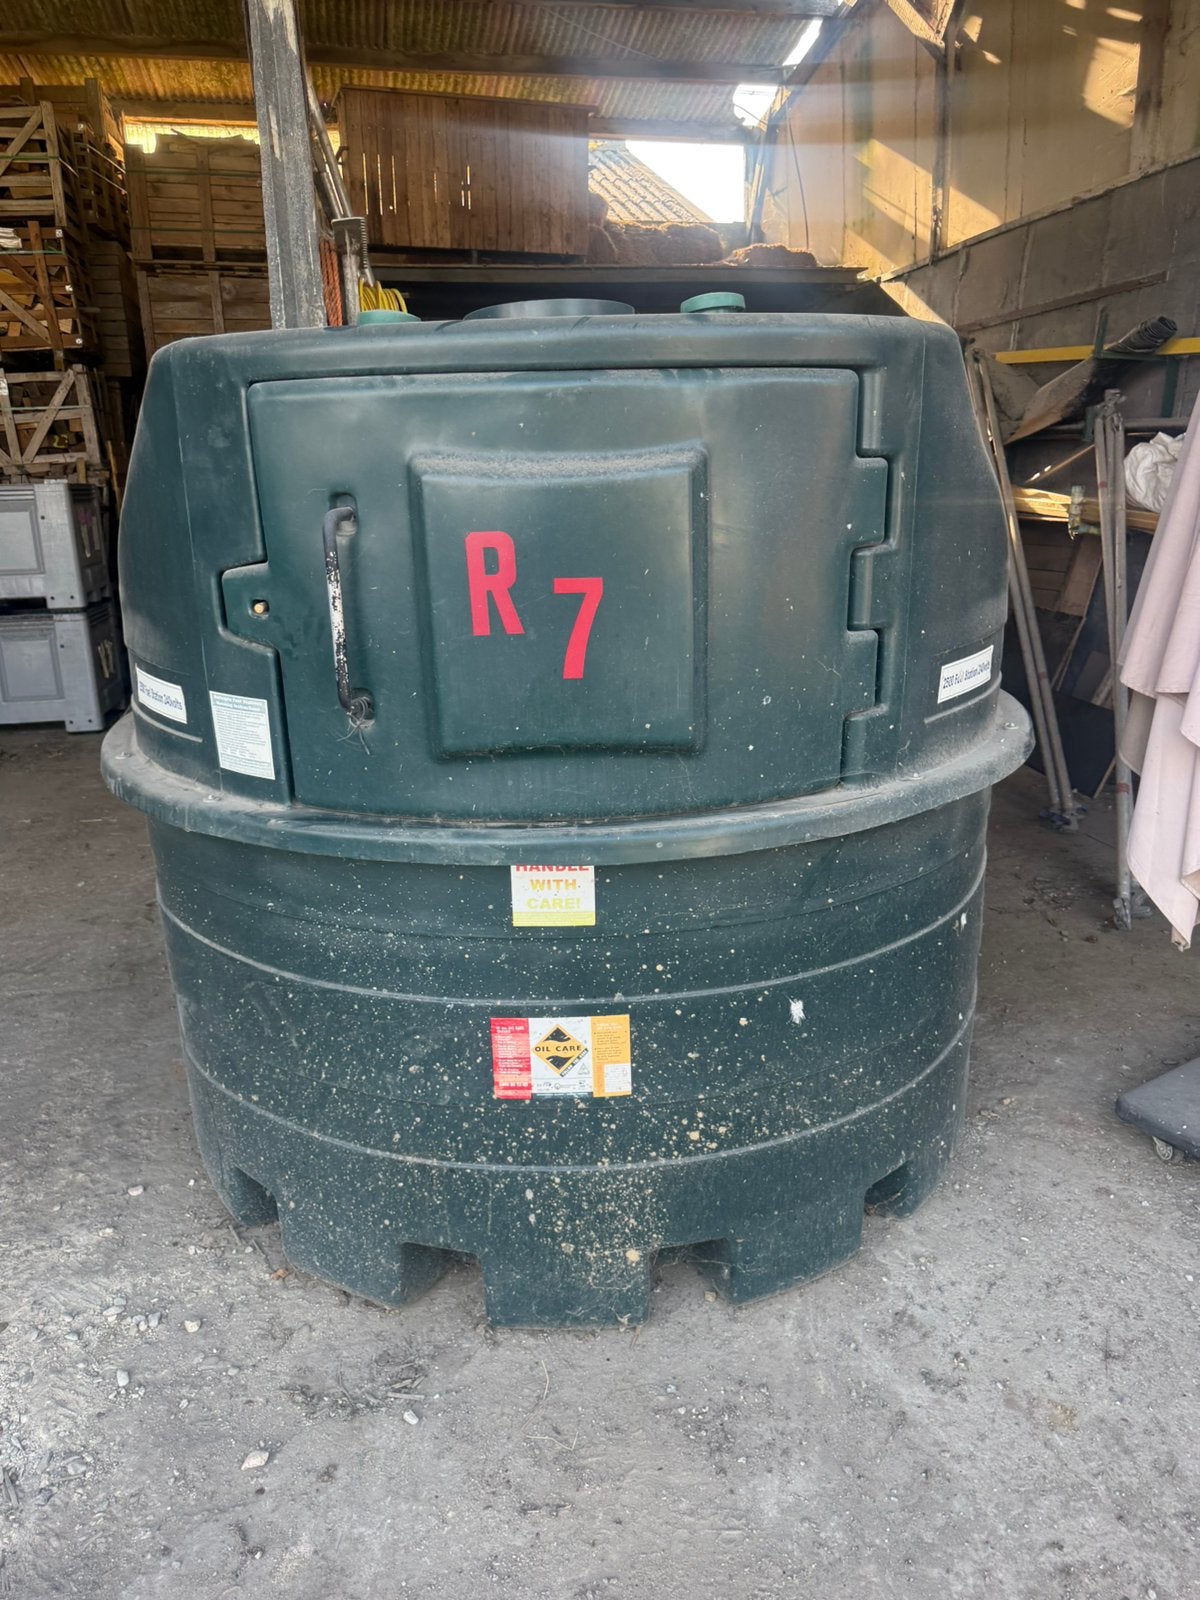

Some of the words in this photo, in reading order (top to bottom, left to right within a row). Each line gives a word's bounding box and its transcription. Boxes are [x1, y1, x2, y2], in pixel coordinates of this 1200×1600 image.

[465, 531, 525, 636] R
[553, 577, 604, 680] 7
[515, 864, 590, 873] HANDLE
[529, 878, 577, 892] WITH
[526, 897, 581, 911] CARE!
[555, 1044, 582, 1052] CARE
